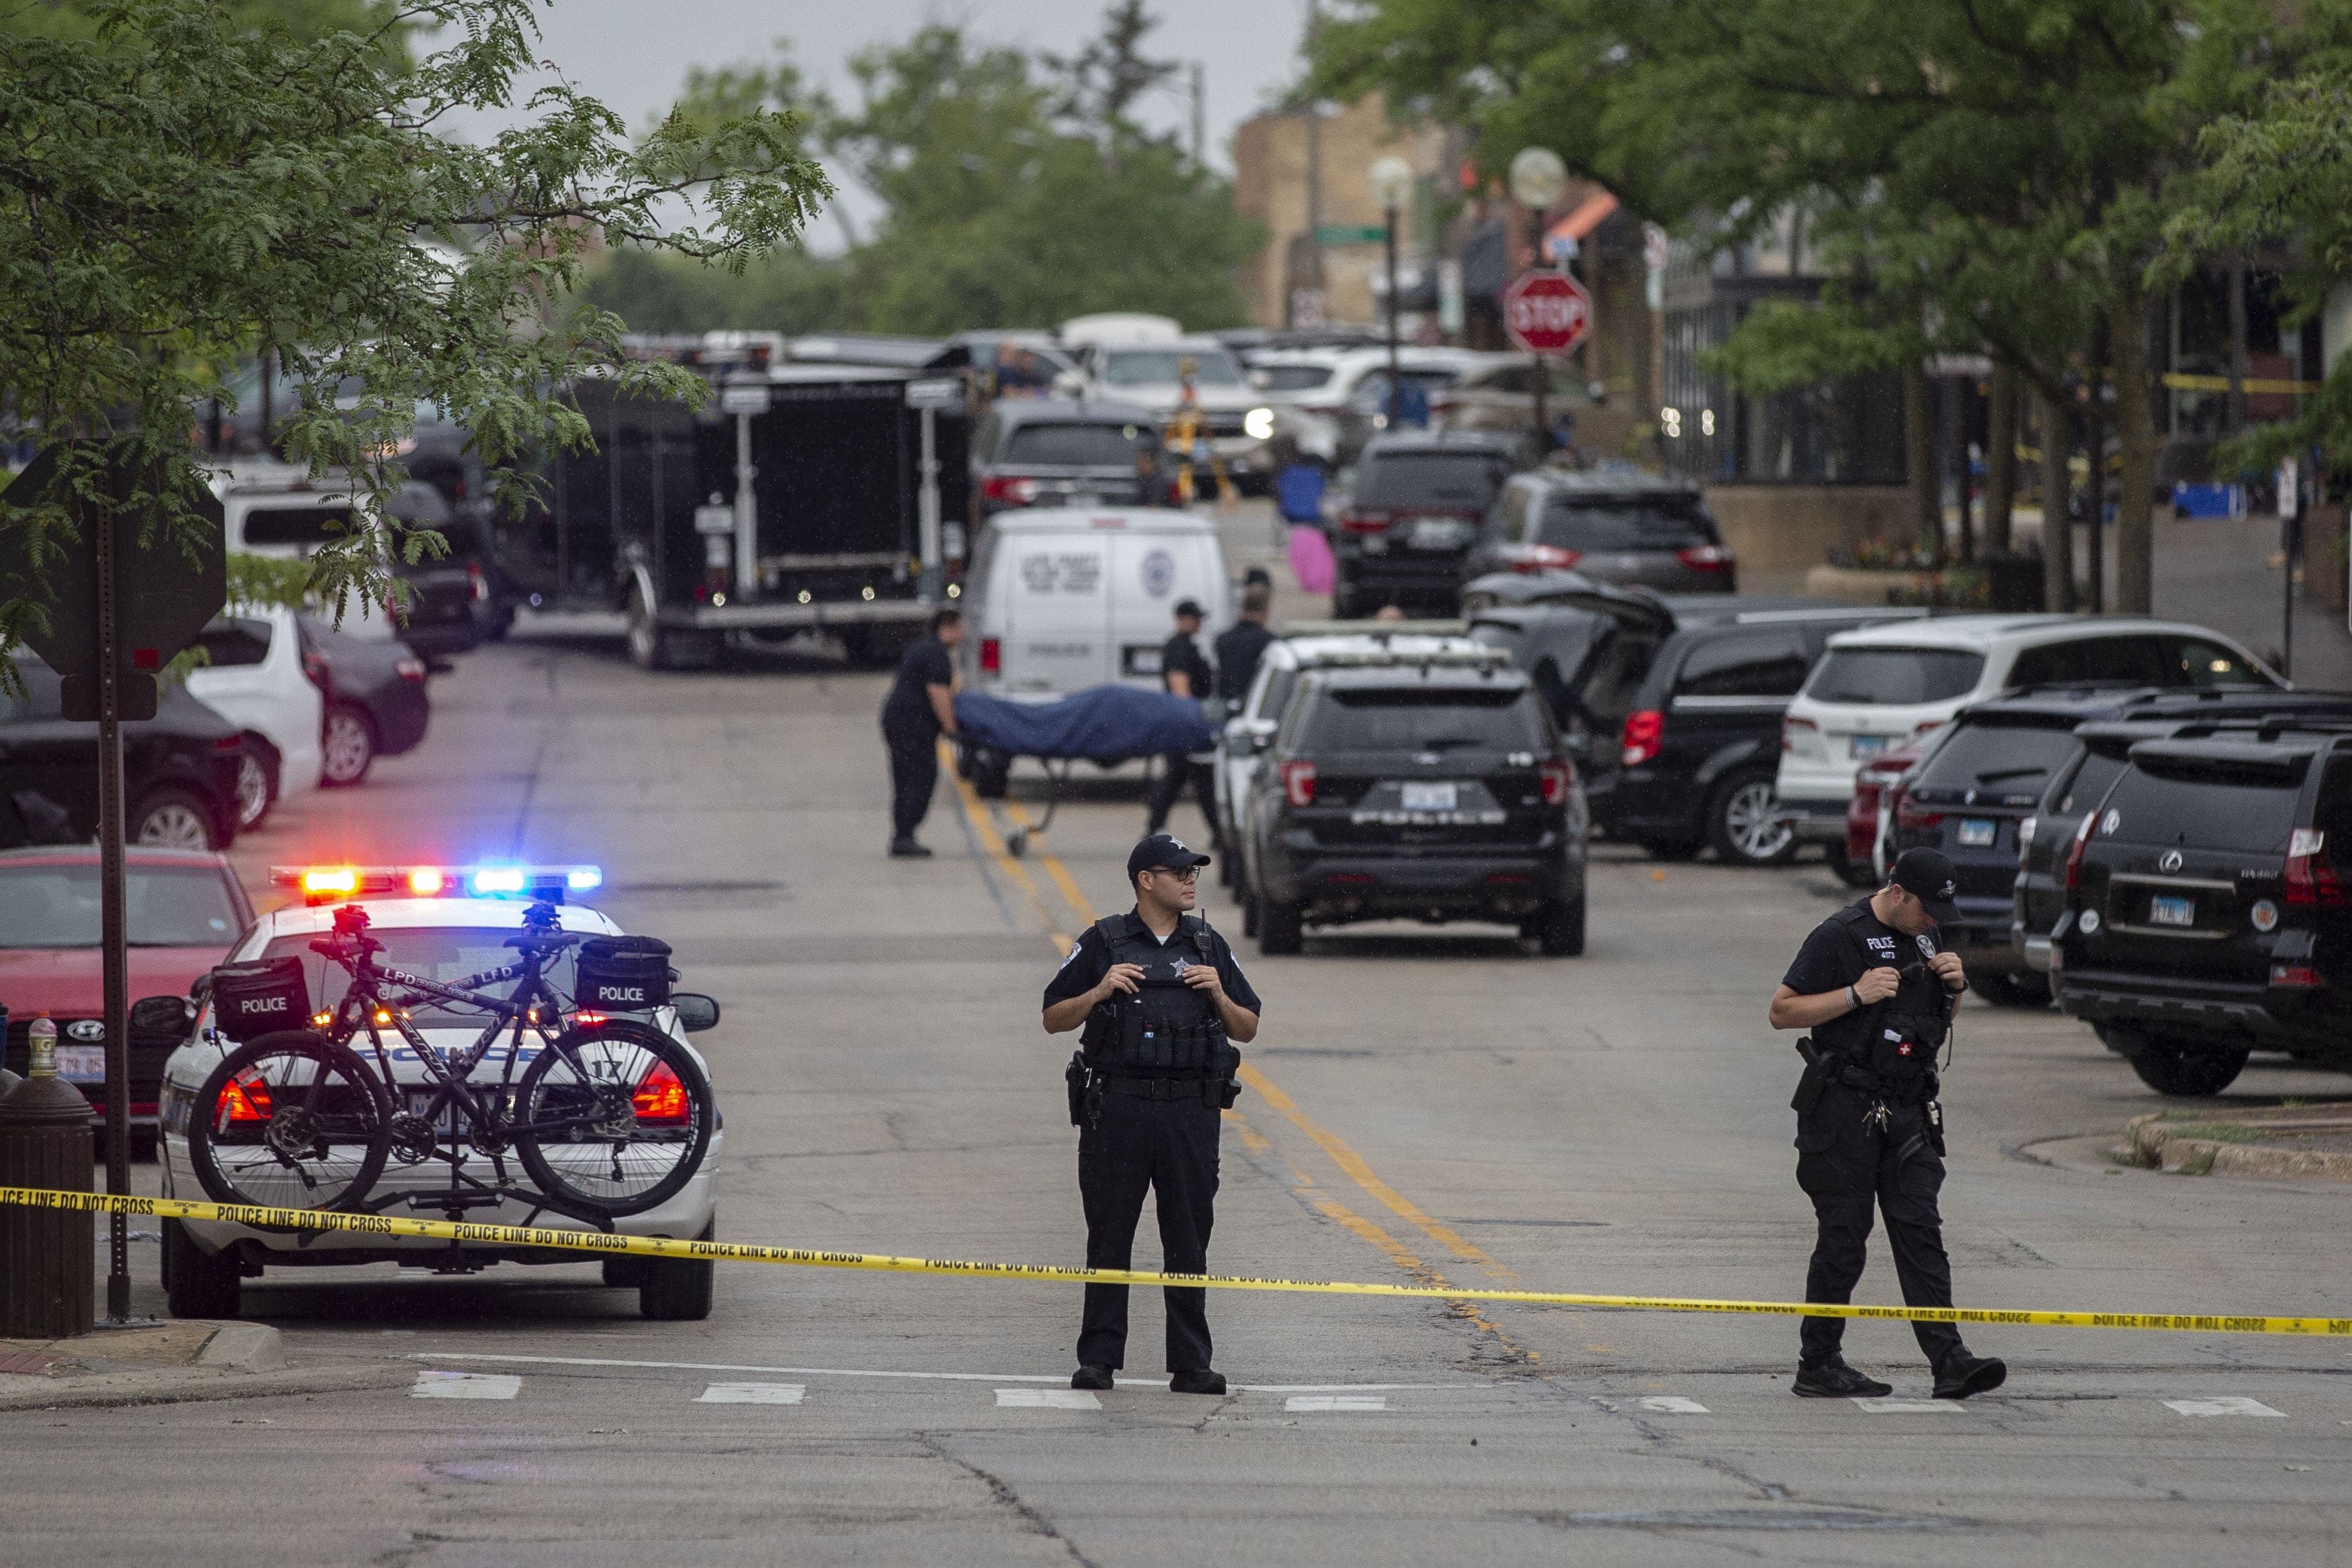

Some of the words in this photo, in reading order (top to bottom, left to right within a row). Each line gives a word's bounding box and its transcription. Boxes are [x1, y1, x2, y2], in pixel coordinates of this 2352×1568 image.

[1513, 296, 1582, 331] STOP
[1867, 937, 1895, 950] POLICE
[481, 966, 513, 983] LFD
[383, 967, 415, 985] LPD
[415, 978, 474, 1001] POLICE
[599, 987, 644, 1001] POLICE
[241, 997, 287, 1013] POLICE
[591, 1060, 623, 1078] 17
[29, 1191, 55, 1207] LINE
[61, 1194, 78, 1209] DO
[82, 1195, 108, 1212] NOT
[111, 1197, 153, 1215] CROSS
[217, 1206, 262, 1225] POLICE
[266, 1209, 294, 1226] LINE
[298, 1211, 316, 1228] DO
[320, 1213, 346, 1230] NOT
[350, 1216, 392, 1234] CROSS
[453, 1224, 499, 1241] POLICE
[503, 1227, 531, 1242] LINE
[535, 1229, 553, 1244] DO
[557, 1232, 582, 1247] NOT
[586, 1234, 628, 1249] CROSS
[690, 1243, 735, 1257] POLICE
[739, 1245, 766, 1258] LINE
[771, 1248, 788, 1260] DO
[792, 1249, 816, 1261] NOT
